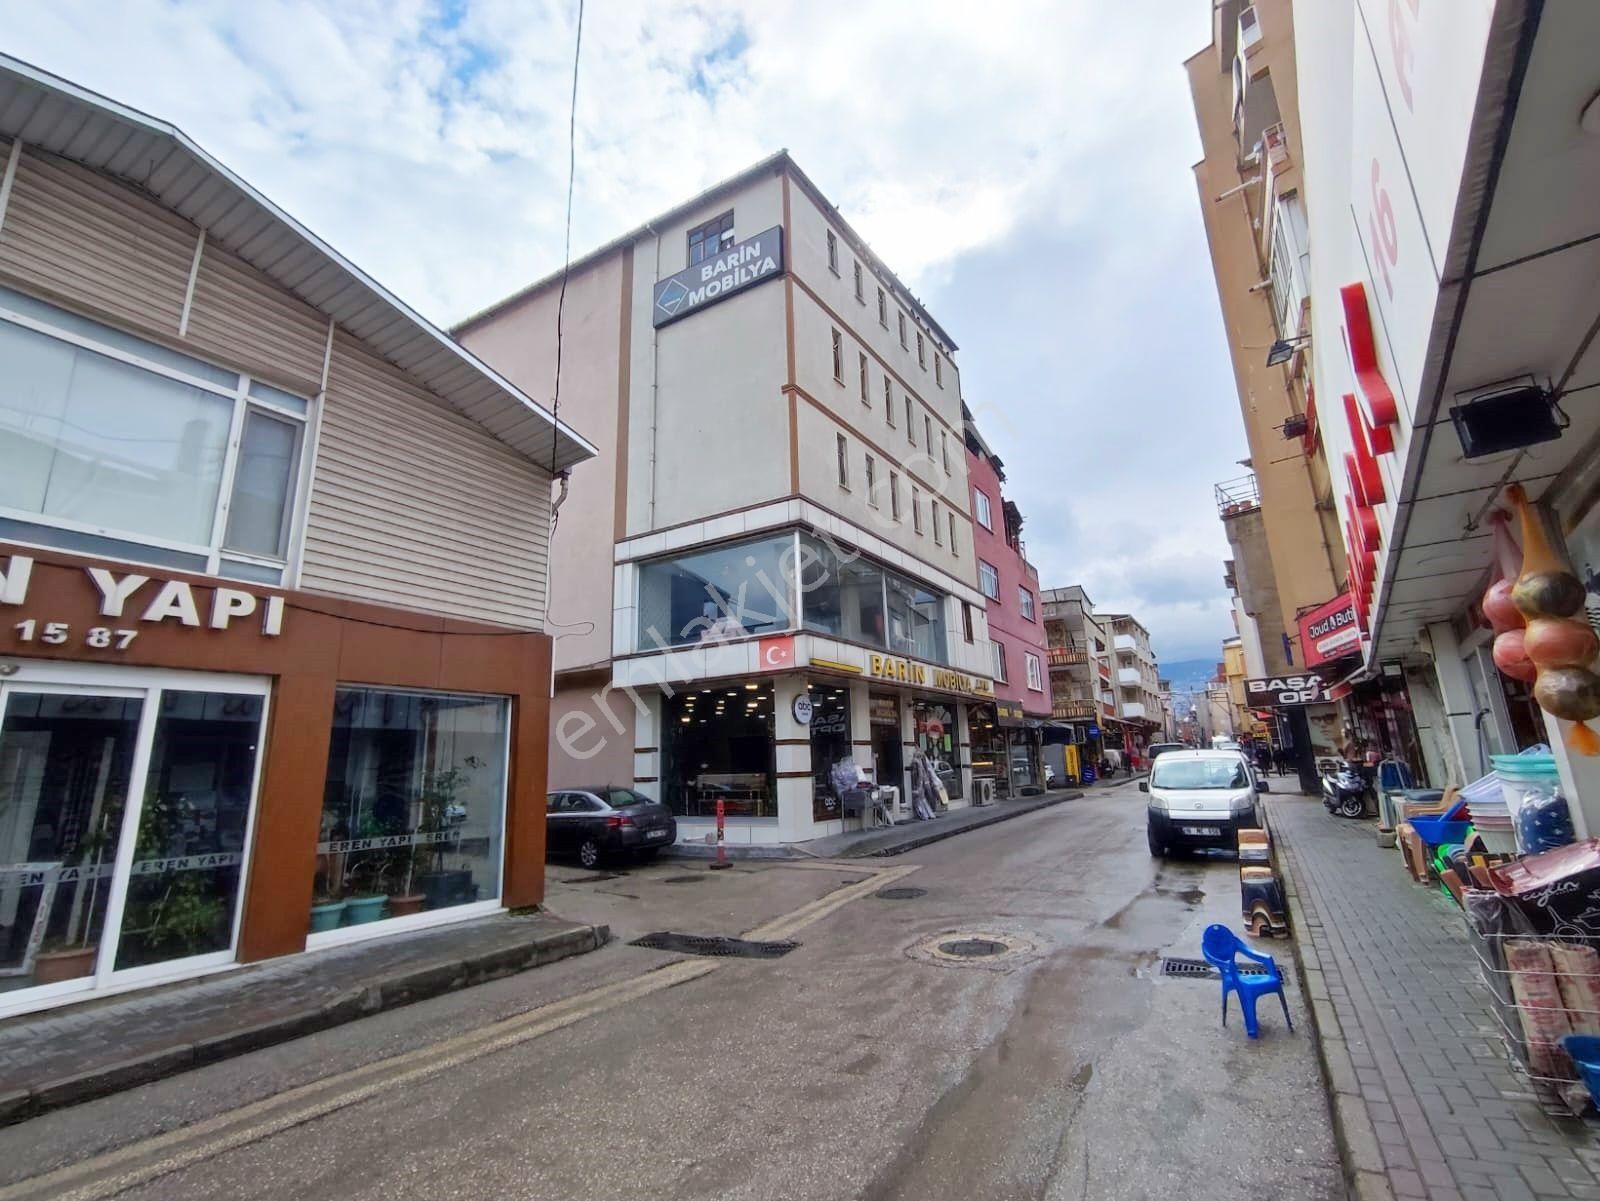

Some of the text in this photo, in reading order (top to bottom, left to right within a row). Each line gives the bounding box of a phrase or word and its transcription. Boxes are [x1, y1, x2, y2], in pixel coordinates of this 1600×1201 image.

[701, 241, 761, 282] BARİN
[688, 256, 777, 306] MOBİLYA
[83, 566, 285, 636] YAPI
[14, 619, 138, 650] 15 87
[869, 654, 926, 685] BARİN
[329, 839, 371, 852] EREN
[381, 834, 412, 847] YAPI
[140, 857, 189, 873] EREN
[198, 853, 234, 867] YAPI
